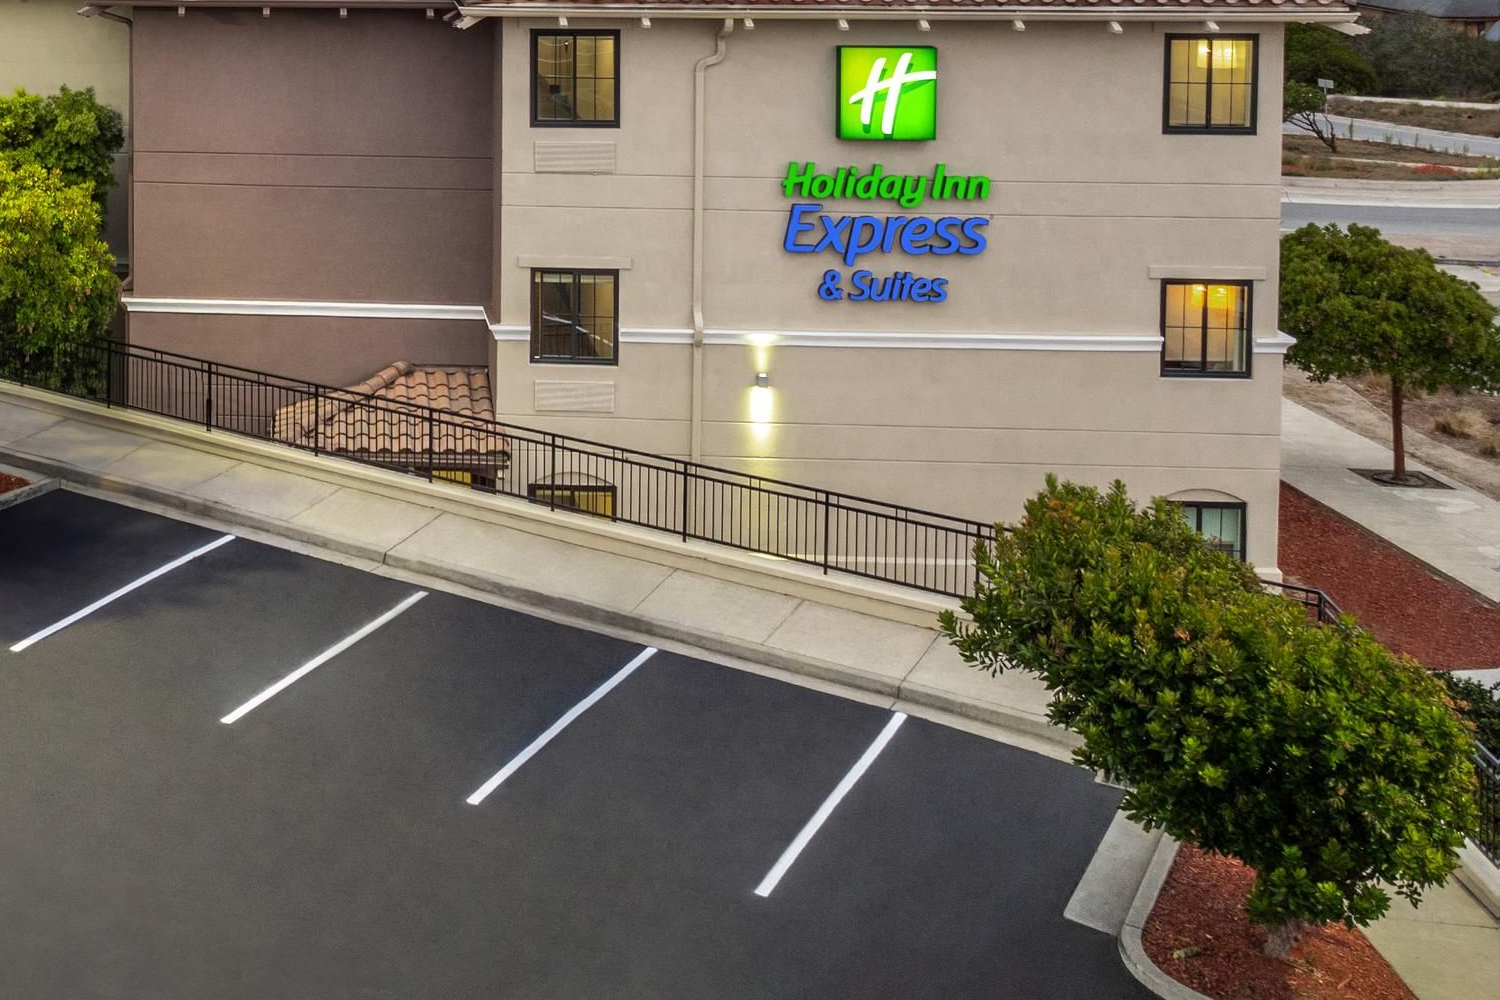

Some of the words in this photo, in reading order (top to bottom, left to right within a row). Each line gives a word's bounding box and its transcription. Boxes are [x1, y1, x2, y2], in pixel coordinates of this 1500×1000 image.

[849, 52, 937, 135] H
[781, 161, 928, 208] Holiday
[932, 164, 992, 200] Inn
[783, 203, 990, 267] Express
[818, 269, 844, 301] &
[848, 270, 948, 302] Suites
